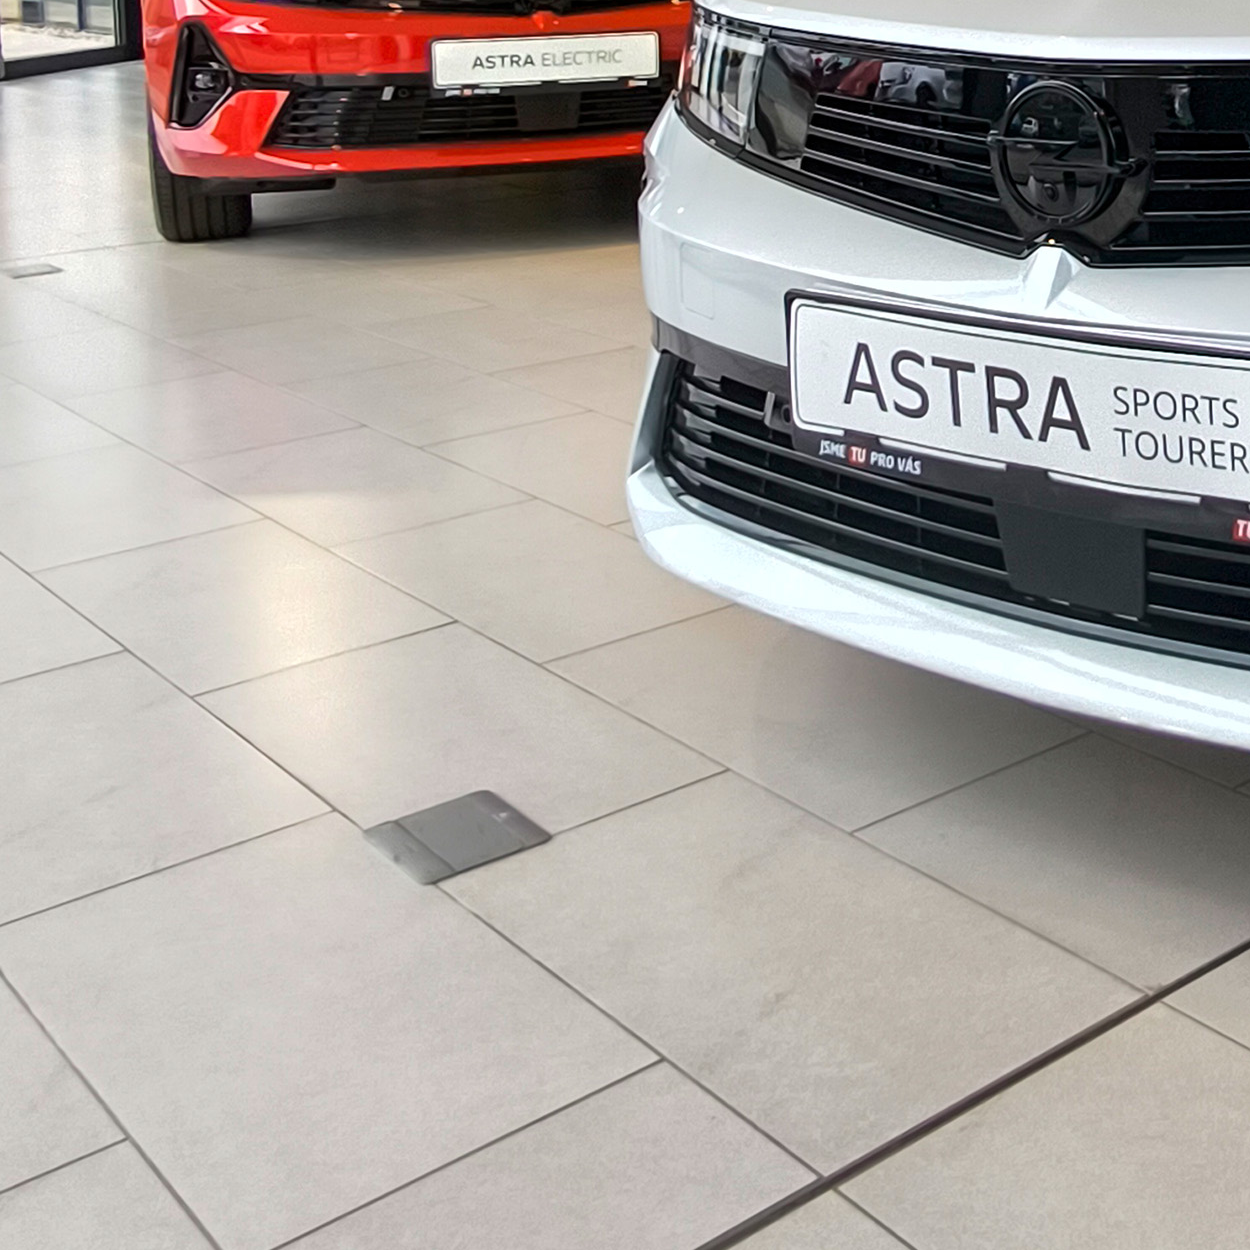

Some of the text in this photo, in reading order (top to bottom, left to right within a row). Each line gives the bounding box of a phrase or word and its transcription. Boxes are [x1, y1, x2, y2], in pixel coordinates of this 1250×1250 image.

[472, 49, 623, 70] ASTRA ELECTRIC
[843, 342, 1091, 452] ASTRA
[1113, 386, 1240, 429] SPORTS
[850, 446, 867, 463] TU
[870, 451, 894, 469] PRO
[897, 456, 921, 475] VÁS
[1113, 427, 1250, 474] TOURER
